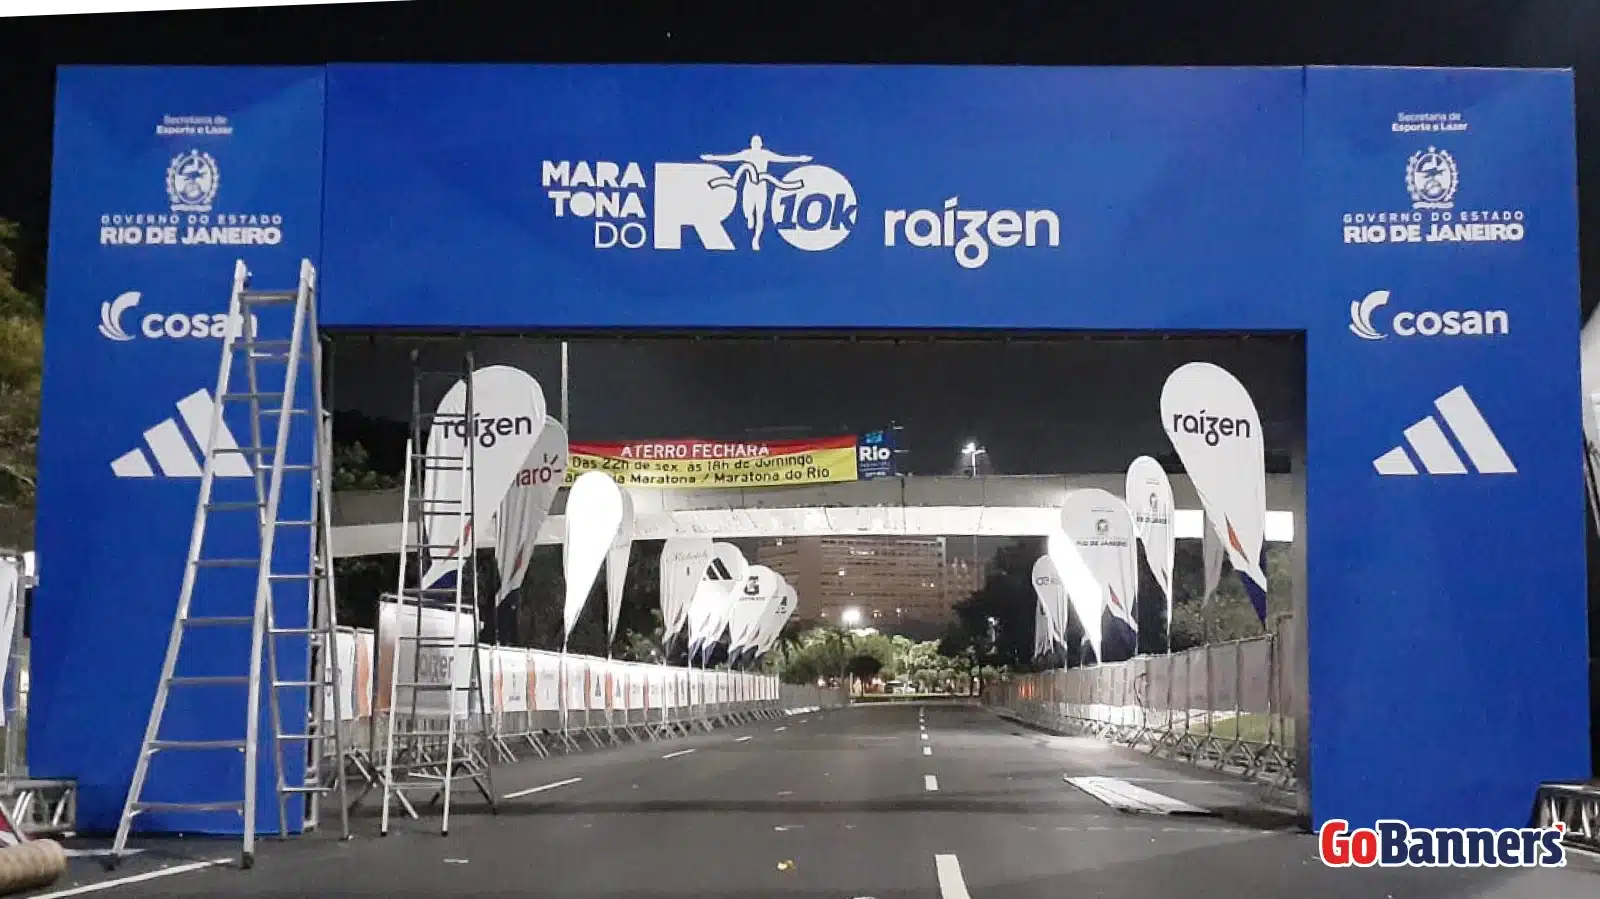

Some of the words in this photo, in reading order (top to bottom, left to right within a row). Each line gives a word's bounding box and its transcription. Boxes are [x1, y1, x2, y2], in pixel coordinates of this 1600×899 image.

[1392, 123, 1431, 133] Esporte
[1440, 122, 1468, 131] Lazer
[101, 214, 180, 225] GOVERNO
[187, 215, 210, 225] DO
[218, 214, 283, 225] ESTADO
[1343, 212, 1423, 224] GOVERNO
[1431, 211, 1452, 222] DO
[1460, 210, 1525, 221] ESTADO
[100, 227, 143, 245] RIO
[145, 227, 178, 245] DE
[181, 226, 282, 245] JANEIRO
[594, 221, 647, 249] DO
[884, 196, 1061, 269] raízen
[1343, 225, 1387, 243] RIO
[1389, 225, 1422, 243] DE
[1425, 223, 1525, 242] JANEIRO
[1393, 310, 1509, 336] cosan
[1173, 409, 1251, 447] raízen
[620, 443, 688, 458] ATERRO
[859, 444, 890, 462] Rio
[572, 456, 598, 469] Das
[634, 461, 650, 470] de
[629, 472, 696, 484] Maratona
[714, 471, 779, 483] Maratona
[784, 469, 802, 480] do
[807, 467, 830, 479] Rio
